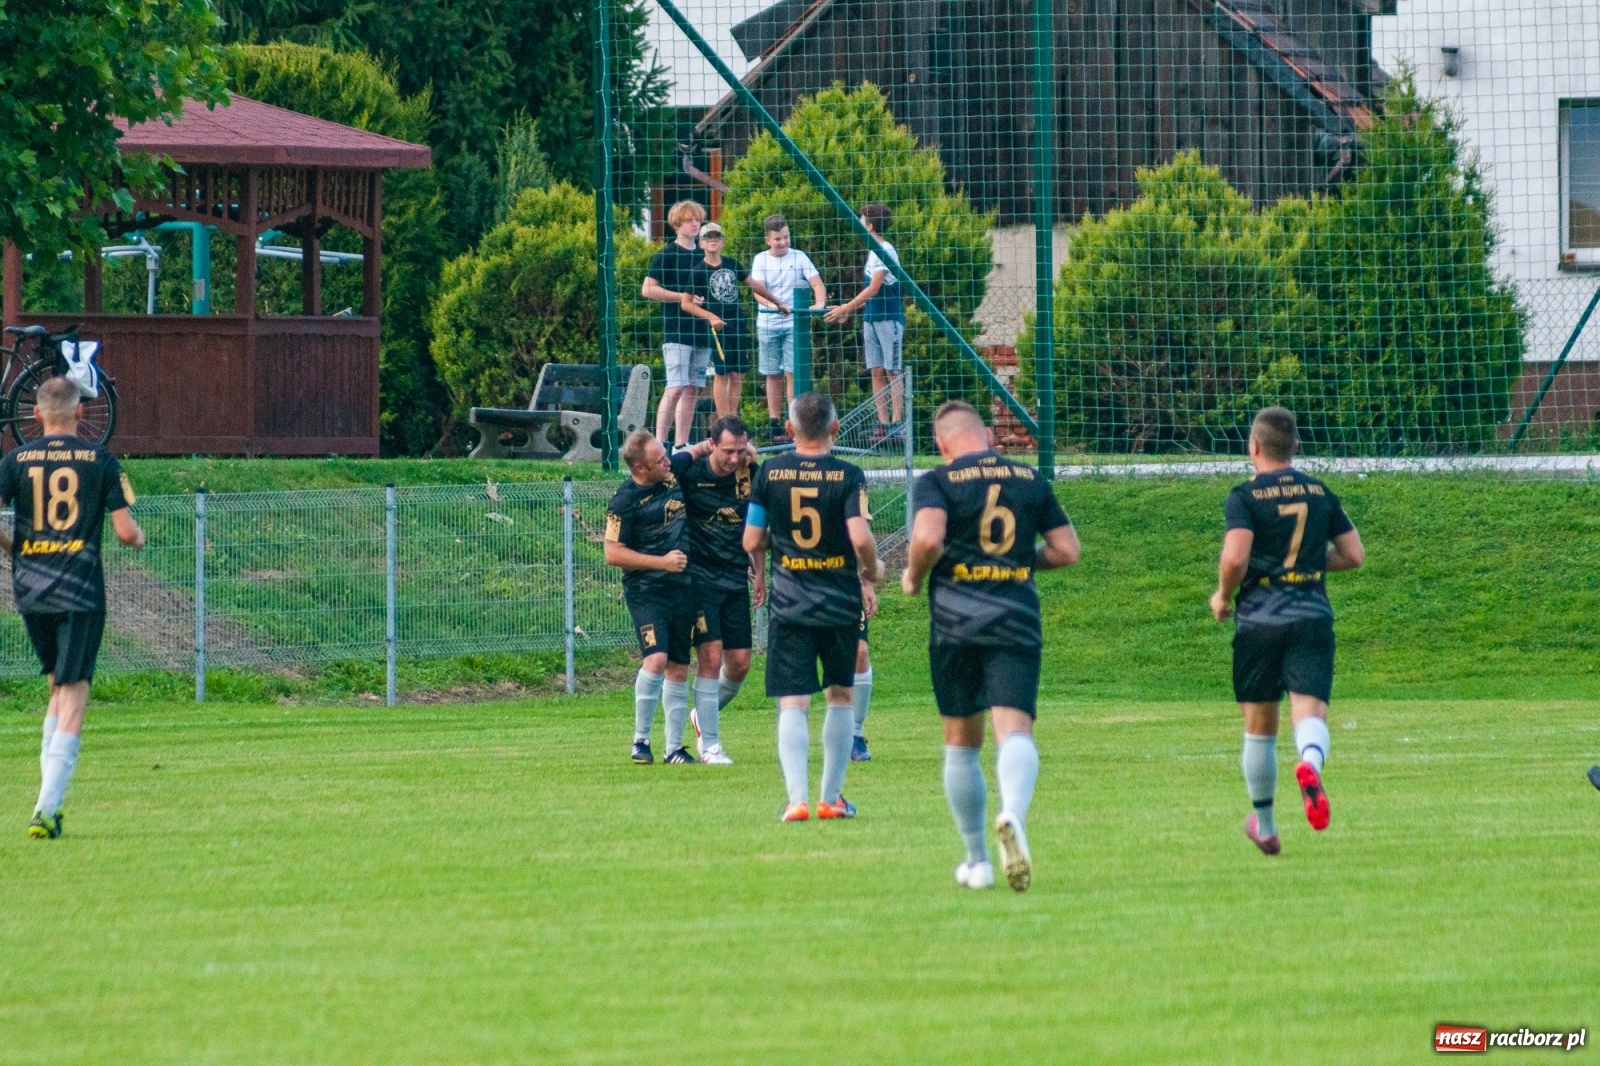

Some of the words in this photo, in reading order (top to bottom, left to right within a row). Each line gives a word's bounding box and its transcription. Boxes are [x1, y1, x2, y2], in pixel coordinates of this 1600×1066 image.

[47, 449, 72, 462] NOWA
[768, 469, 797, 481] CZARNI
[799, 470, 823, 481] NOWA
[28, 466, 79, 532] 18
[790, 487, 822, 549] 5
[980, 483, 1016, 556] 6
[1278, 502, 1308, 569] 7
